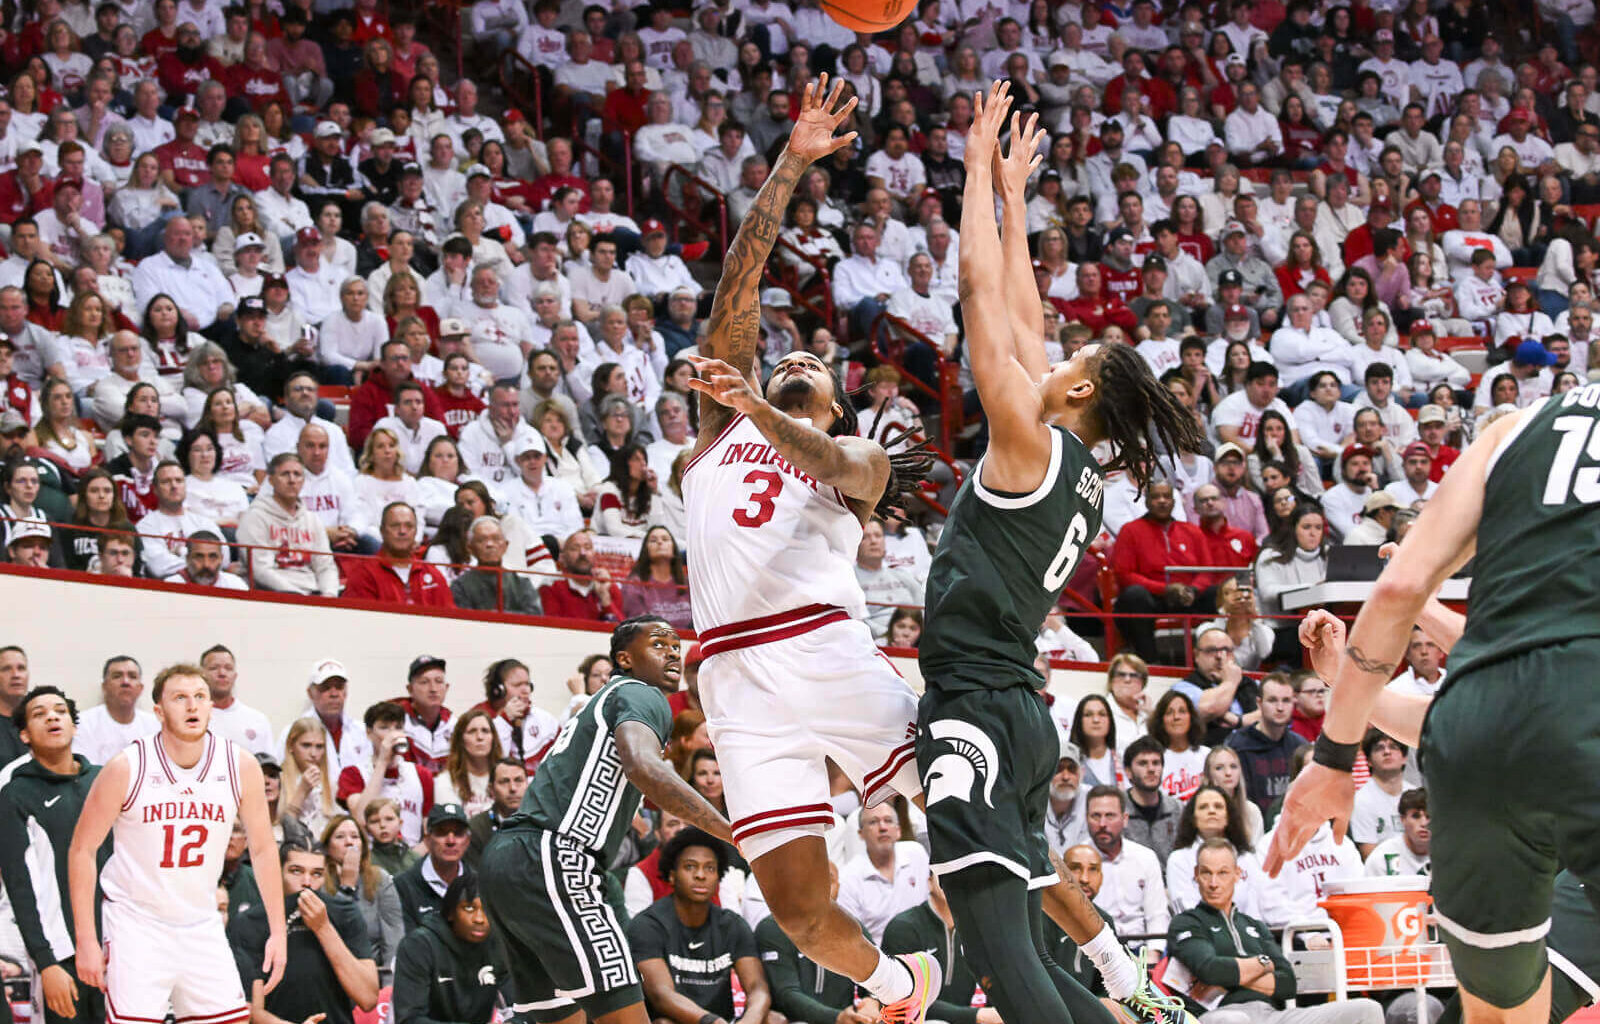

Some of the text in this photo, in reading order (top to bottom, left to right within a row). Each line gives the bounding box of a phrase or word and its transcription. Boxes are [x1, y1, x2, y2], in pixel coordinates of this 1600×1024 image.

[1561, 383, 1600, 410] CO
[731, 468, 784, 528] 3
[1043, 511, 1088, 593] 6
[143, 802, 226, 824] INDIANA
[159, 825, 209, 868] 12
[1297, 853, 1340, 873] NDIANA
[1397, 906, 1421, 937] G
